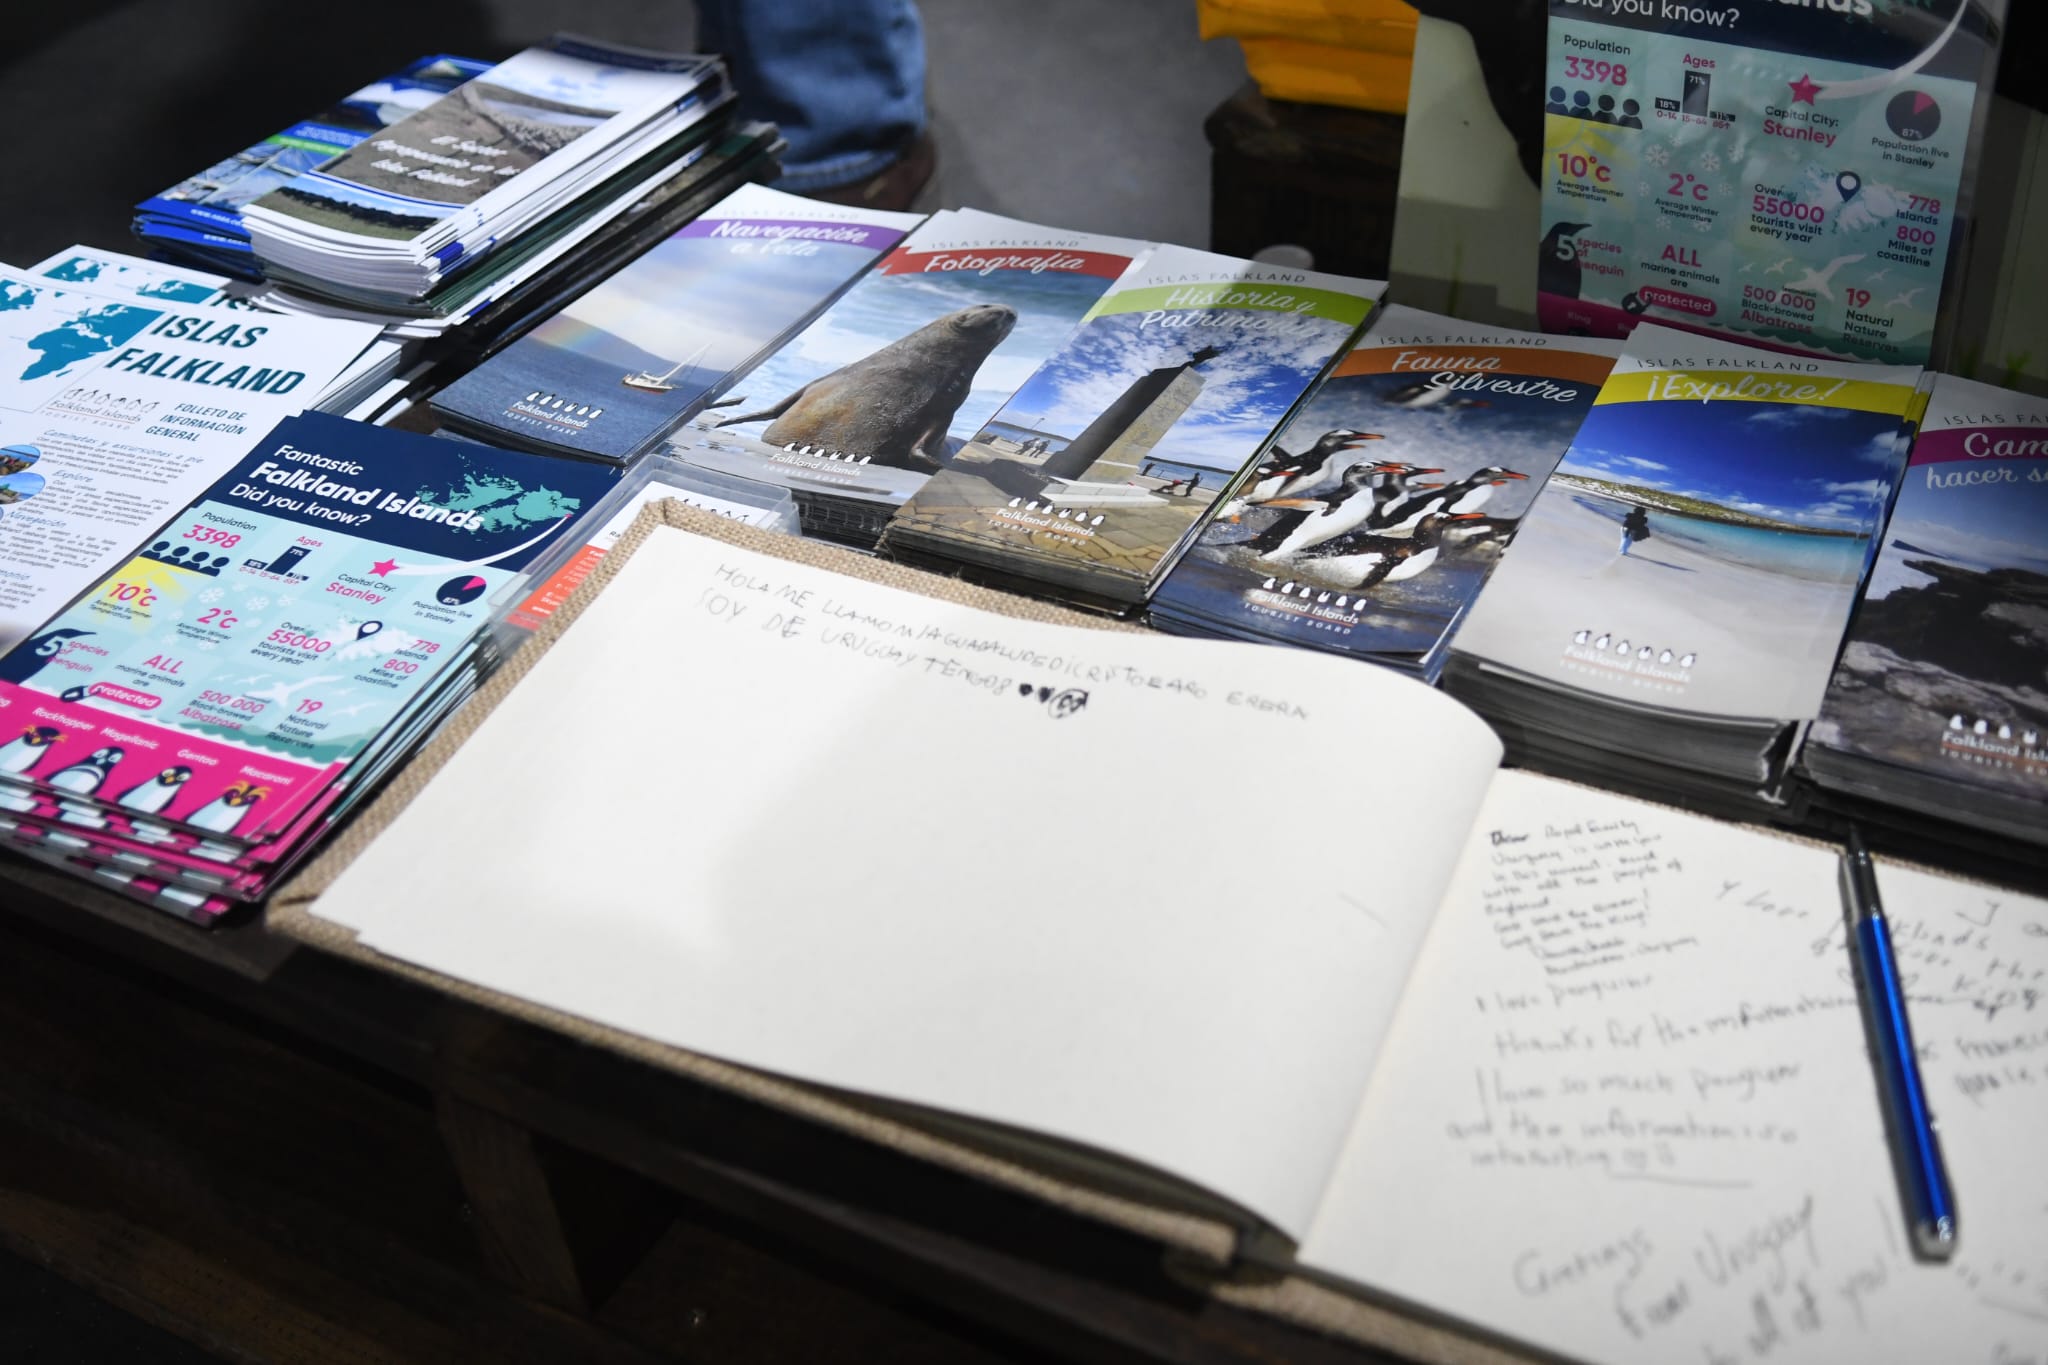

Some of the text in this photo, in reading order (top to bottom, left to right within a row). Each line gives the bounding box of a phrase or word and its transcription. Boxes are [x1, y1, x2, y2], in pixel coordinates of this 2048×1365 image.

[1661, 0, 1740, 28] know?
[1564, 34, 1631, 55] Population
[1564, 56, 1627, 86] 3398
[1683, 54, 1716, 69] Ages
[1764, 106, 1839, 127] Capital City:
[1763, 120, 1837, 148] Stanley
[1871, 137, 1949, 158] Population live
[1883, 152, 1935, 169] in Stanley
[1557, 179, 1624, 198] Average Summer
[1557, 187, 1607, 203] Temperature
[1754, 184, 1783, 196] Over
[1655, 198, 1719, 217] Average Winter
[1753, 195, 1824, 223] 55000
[1909, 195, 1941, 214] 778
[1660, 207, 1712, 223] Temperature
[1752, 214, 1823, 235] tourists visit
[710, 220, 870, 246] Navegación
[1750, 225, 1813, 244] every year
[1896, 226, 1935, 245] 800
[932, 239, 1080, 249] ISLAS FALKLAND
[1556, 233, 1622, 261] 5 species
[1888, 240, 1933, 256] Miles of
[924, 253, 1085, 277] Fotografía
[1661, 244, 1702, 268] ALL
[1877, 250, 1931, 267] coastline
[1148, 273, 1306, 285] ISLAS FALKLAND
[1641, 262, 1720, 285] marine animals
[1670, 278, 1688, 288] are
[1165, 287, 1296, 307] Historia
[1644, 290, 1713, 312] protected
[1744, 285, 1776, 303] 500
[1781, 293, 1815, 311] 000
[1846, 288, 1871, 308] 19
[1741, 299, 1814, 322] Black-browed
[1847, 310, 1893, 327] Natural
[150, 314, 268, 348] ISLAS
[1140, 310, 1321, 337] Patrimonio
[1741, 310, 1813, 334] Albatross
[1845, 322, 1887, 338] Nature
[1381, 336, 1548, 346] ISLAS FALKLAND
[1843, 333, 1899, 352] Reserves
[104, 348, 306, 394] FALKLAND
[1391, 351, 1502, 372] Fauna
[1637, 358, 1820, 372] ISLAS FALKLAND
[1424, 370, 1579, 403] Silvestre
[1647, 373, 1847, 404] ¡Explore!
[50, 399, 141, 423] Falkland Islands
[174, 402, 247, 421] FOLLETO DE
[512, 400, 590, 429] Falkland Islands
[1944, 414, 2005, 425] ISLAS
[145, 425, 201, 442] GENERAL
[159, 413, 247, 435] INFORMACIÓN
[273, 444, 364, 476] Fantastic
[770, 453, 862, 477] Falkland Islands
[1926, 466, 2018, 489] hacer
[228, 483, 372, 527] Did you know?
[249, 461, 485, 531] Falkland Islands
[201, 512, 257, 532] Population
[996, 508, 1096, 537] Falkland Islands
[182, 524, 241, 549] 3398
[295, 535, 323, 547] Ages
[325, 581, 386, 605] Stanley
[338, 573, 397, 593] Capital City:
[716, 563, 769, 592] HOLA
[775, 584, 815, 608] ME
[89, 604, 132, 620] Temperature
[95, 599, 124, 611] Average
[413, 600, 473, 618] Population live
[1250, 590, 1359, 624] Falkland Islands
[280, 621, 305, 633] Over
[424, 611, 454, 624] Stanley
[1244, 603, 1351, 635] TOURIST BOARD
[176, 622, 204, 634] Average
[176, 629, 220, 644] Temperature
[35, 635, 110, 656] 5 species
[267, 629, 331, 653] 55000
[410, 639, 441, 654] 778
[761, 613, 806, 639] DE
[820, 626, 917, 666] URUGUAY
[250, 649, 304, 665] every year
[258, 641, 319, 660] tourists visit
[143, 655, 183, 674] ALL
[370, 667, 398, 679] Miles
[383, 659, 419, 674] 800
[114, 663, 186, 688] marine animals
[132, 678, 150, 687] are
[354, 674, 399, 689] coastline
[92, 684, 160, 707] protected
[198, 690, 232, 706] 500
[188, 699, 254, 721] Black-browed
[296, 698, 324, 714] 19
[32, 707, 96, 731] Rockhopper
[178, 707, 244, 731] Albatross
[286, 713, 330, 730] Natural
[100, 727, 160, 750] Magellanic
[265, 731, 315, 750] Reserves
[276, 722, 314, 739] Nature
[1941, 730, 2019, 757] Falkland
[176, 749, 219, 767] Gentoo
[239, 765, 294, 786] Macaroni
